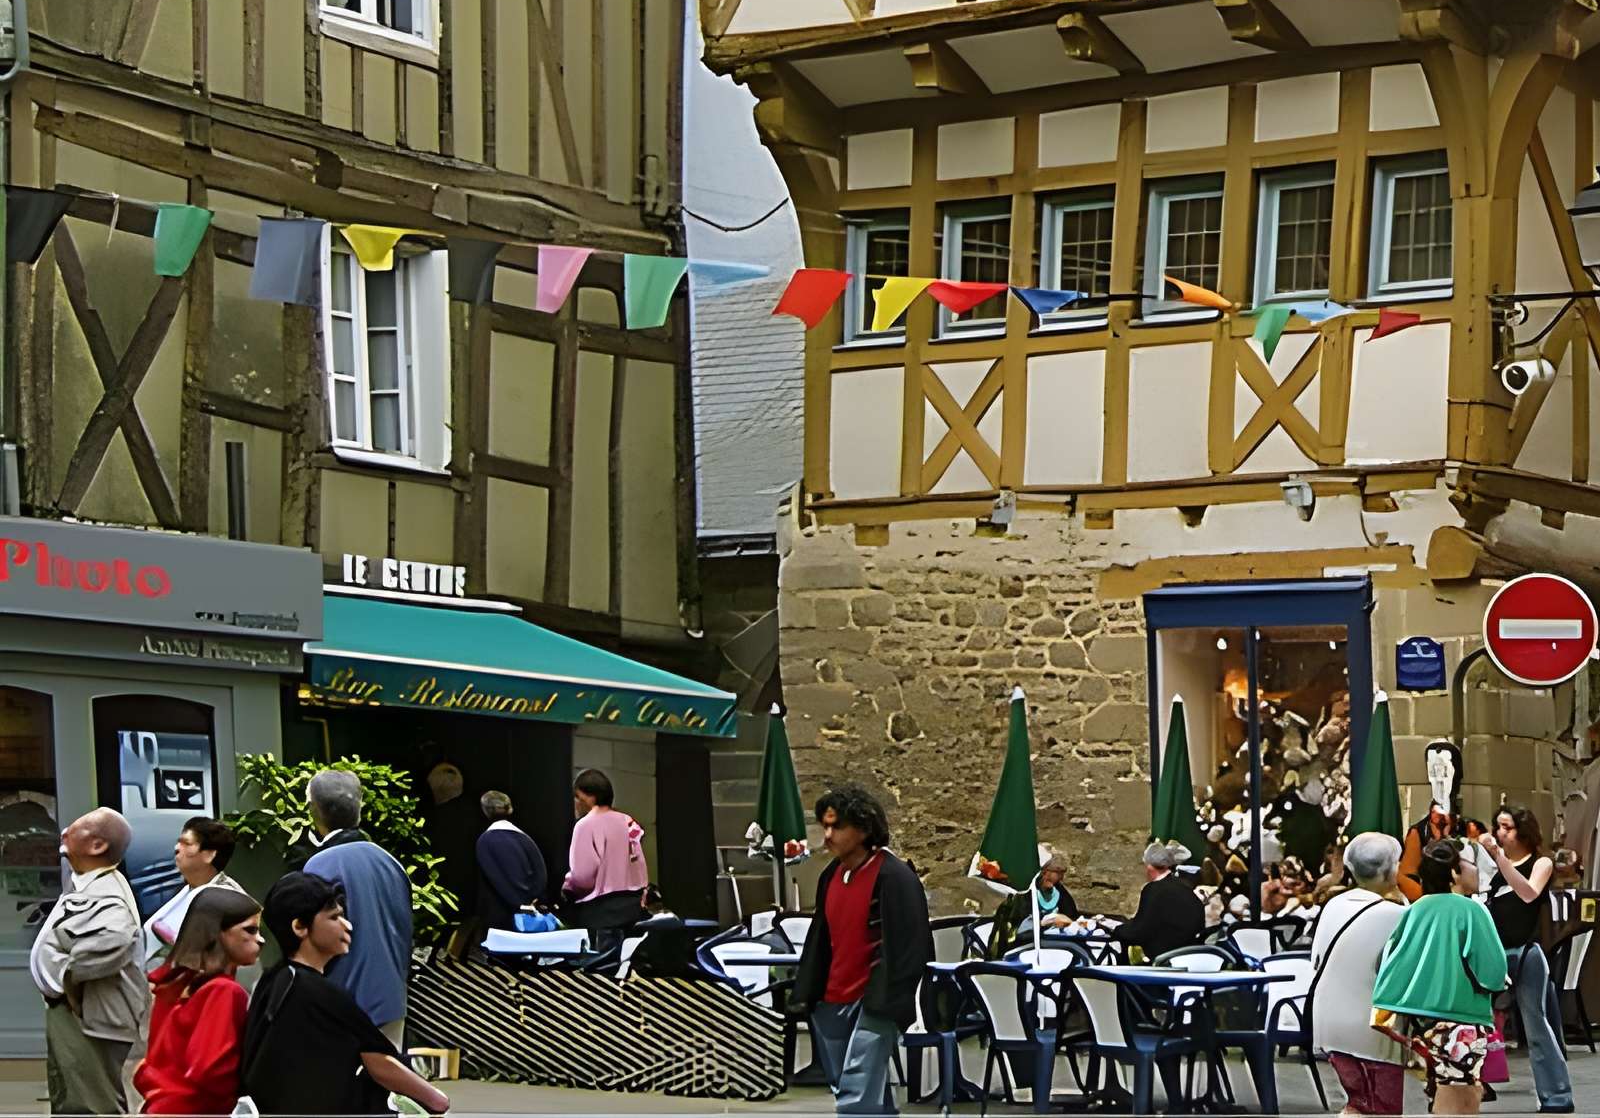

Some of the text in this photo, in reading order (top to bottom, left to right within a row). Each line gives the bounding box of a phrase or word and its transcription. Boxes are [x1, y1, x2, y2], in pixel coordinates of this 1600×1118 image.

[0, 538, 172, 599] Photo
[343, 553, 368, 585] LE
[404, 676, 560, 713] Restaurant
